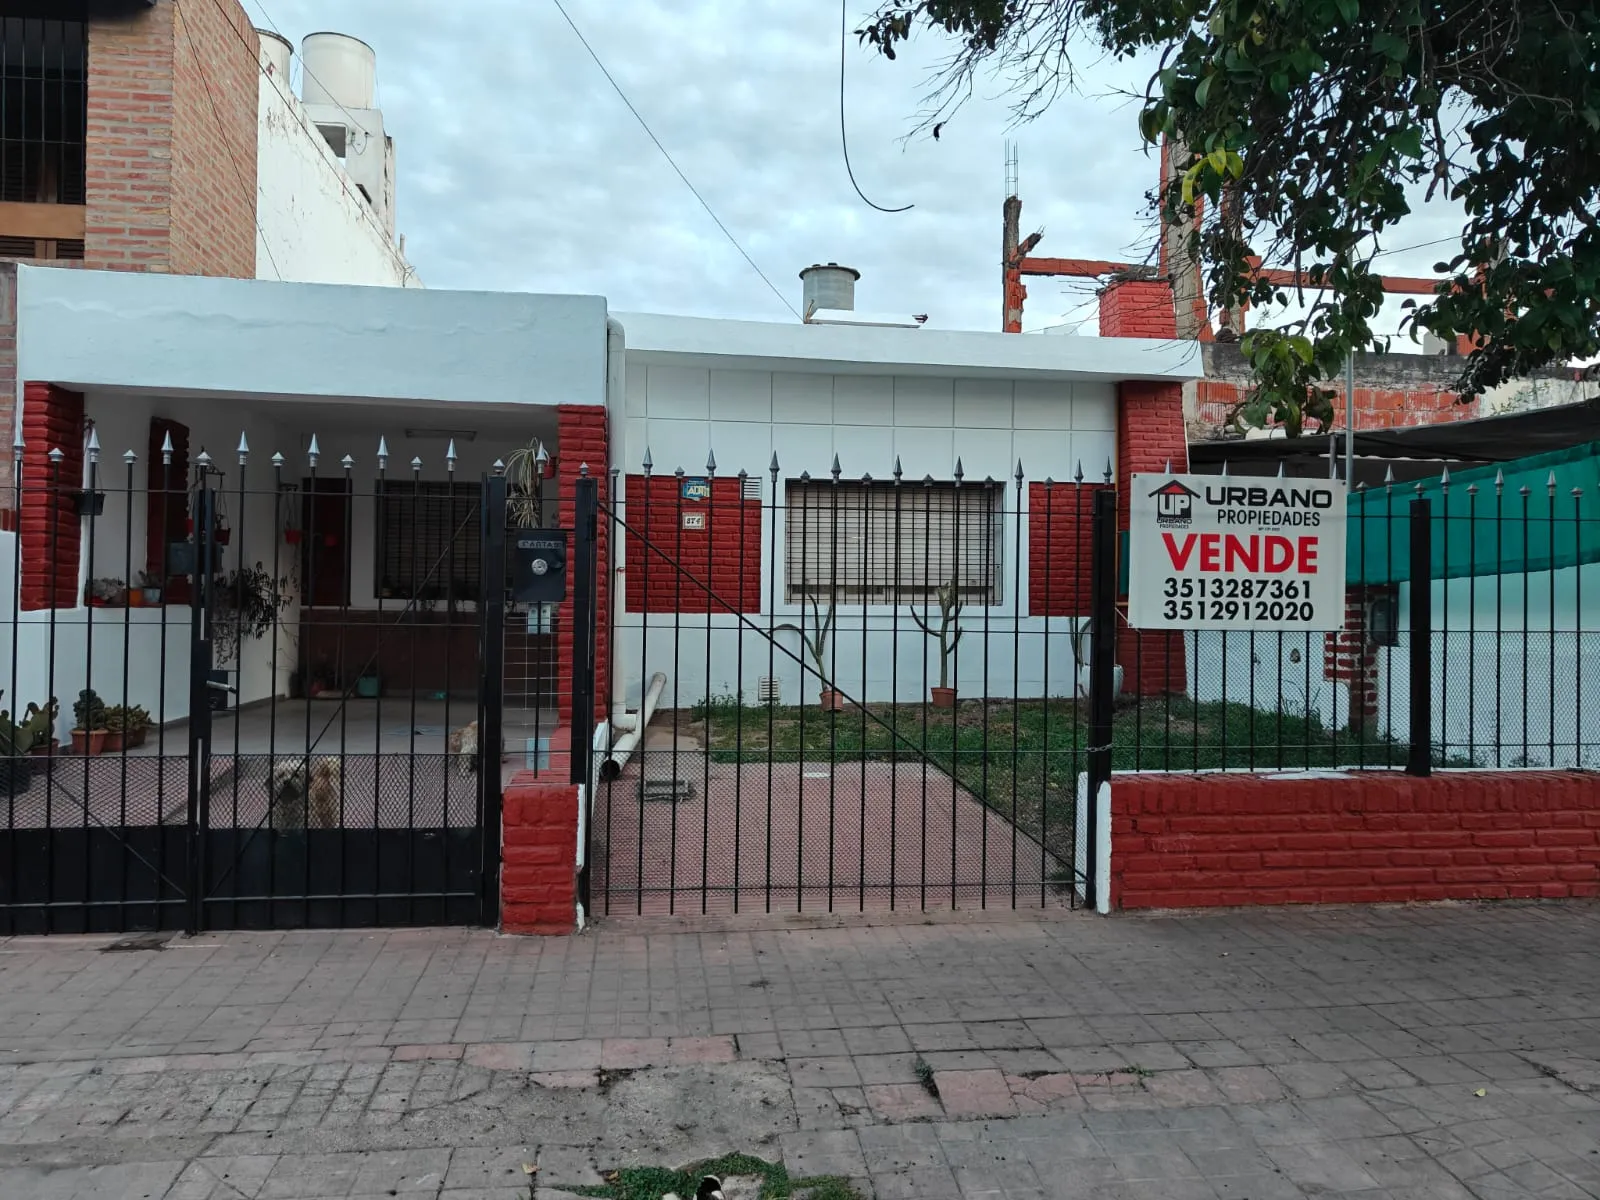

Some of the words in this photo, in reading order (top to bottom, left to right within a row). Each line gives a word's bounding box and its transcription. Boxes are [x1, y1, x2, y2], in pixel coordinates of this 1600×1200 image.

[1159, 494, 1190, 516] UP
[1206, 486, 1333, 509] URBANO
[1157, 517, 1192, 525] URBANO
[1217, 509, 1321, 527] PROPIEDADES
[1161, 532, 1319, 575] VENDE
[1163, 577, 1311, 600] 3513287361
[1163, 600, 1314, 622] 3512912020
